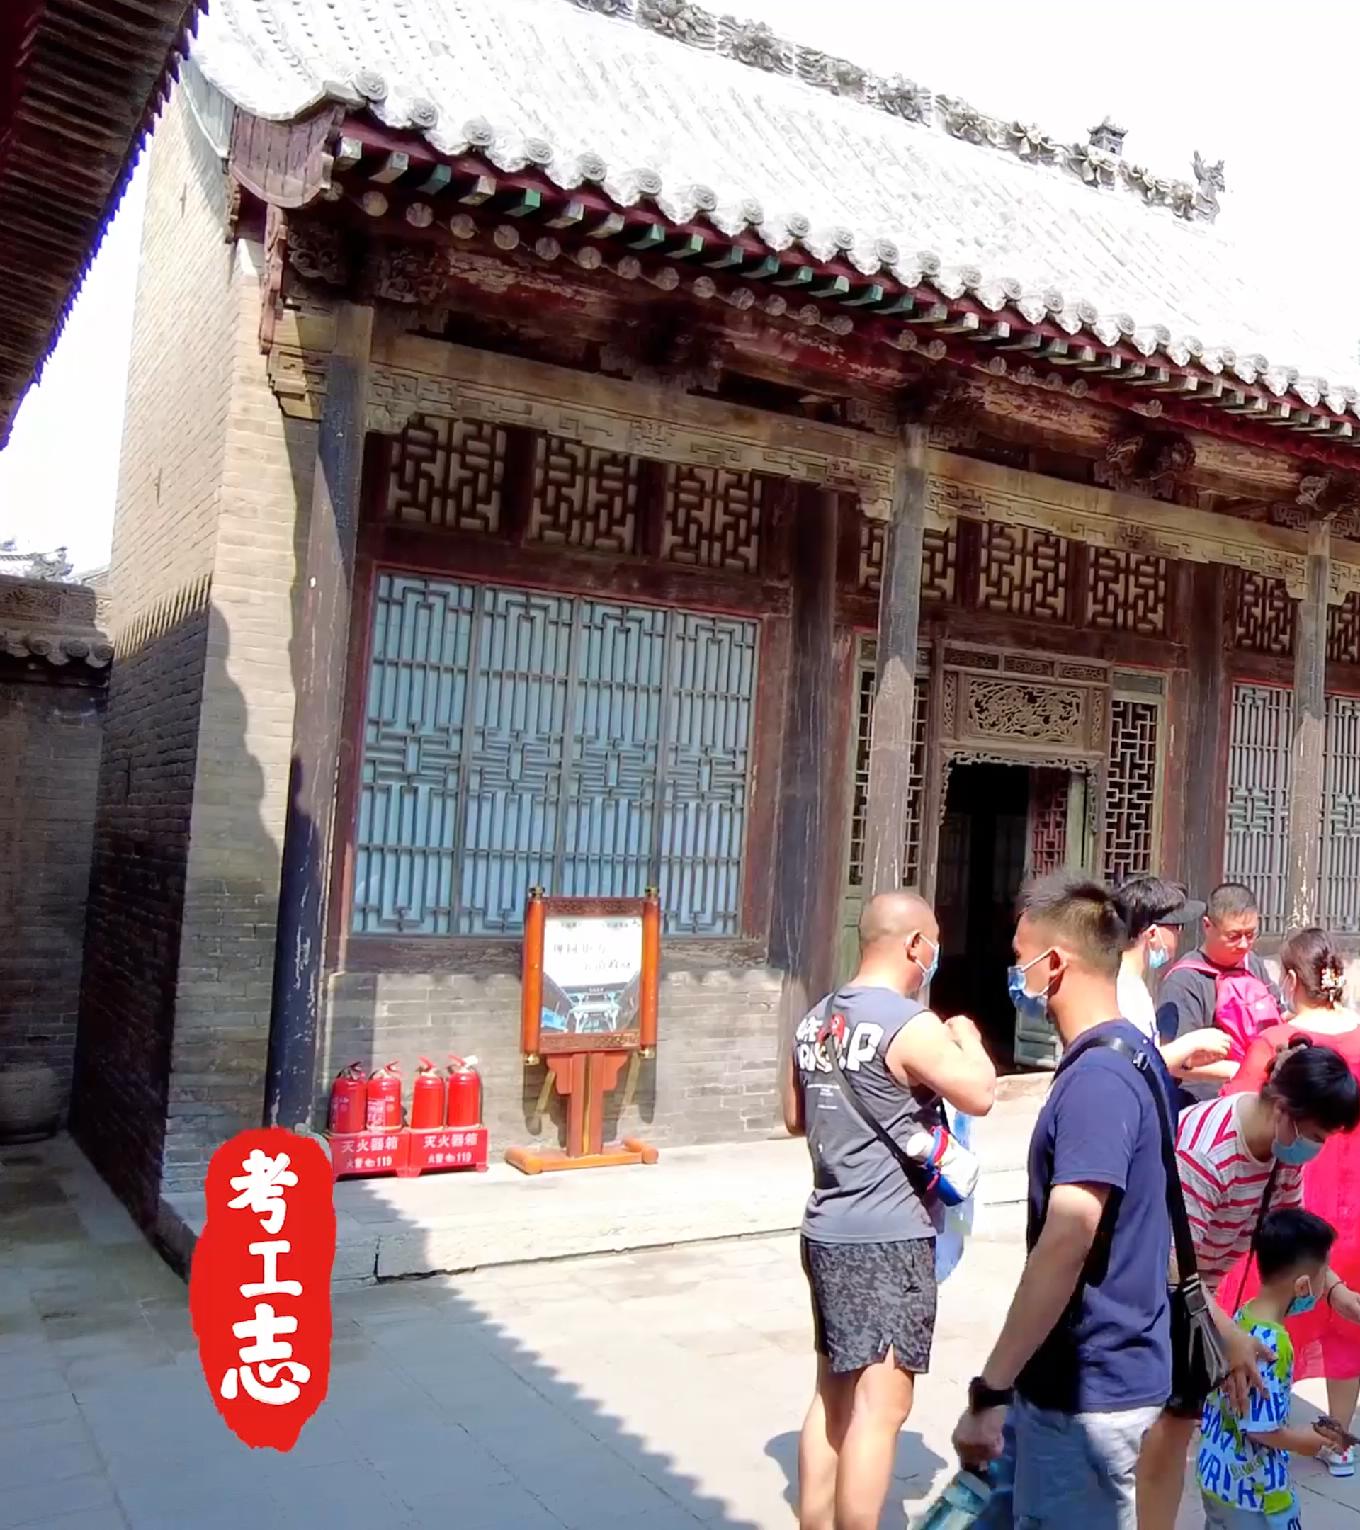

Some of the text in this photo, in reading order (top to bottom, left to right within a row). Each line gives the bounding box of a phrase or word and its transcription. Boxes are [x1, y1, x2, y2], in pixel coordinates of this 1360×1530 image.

[341, 1135, 398, 1153] 灭火器箱
[423, 1132, 478, 1149] 灭火器箱
